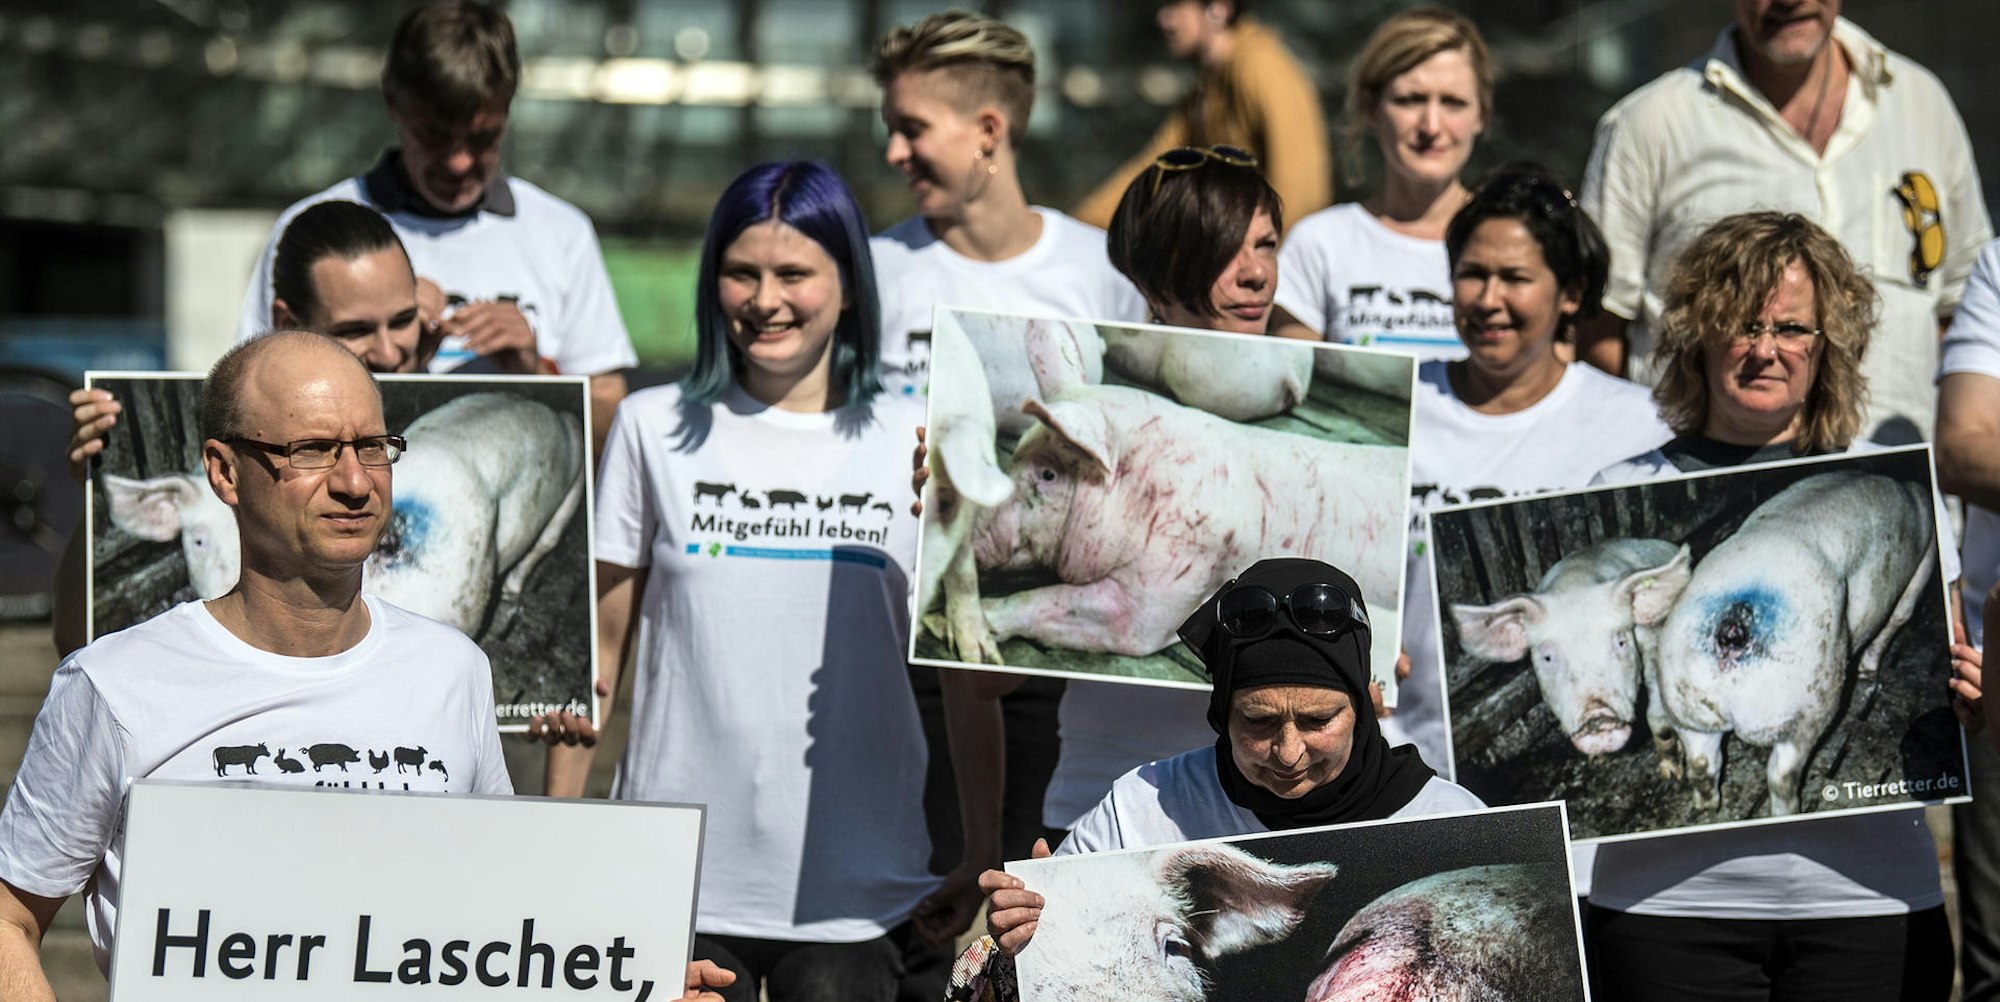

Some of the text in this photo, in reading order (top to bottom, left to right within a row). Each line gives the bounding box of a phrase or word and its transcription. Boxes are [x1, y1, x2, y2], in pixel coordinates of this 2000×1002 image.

[690, 513, 889, 546] Mitgefühl leben!
[496, 697, 588, 718] erretterde
[1842, 771, 1959, 800] Tierretter.de
[152, 907, 656, 1002] Herr Laschet,
